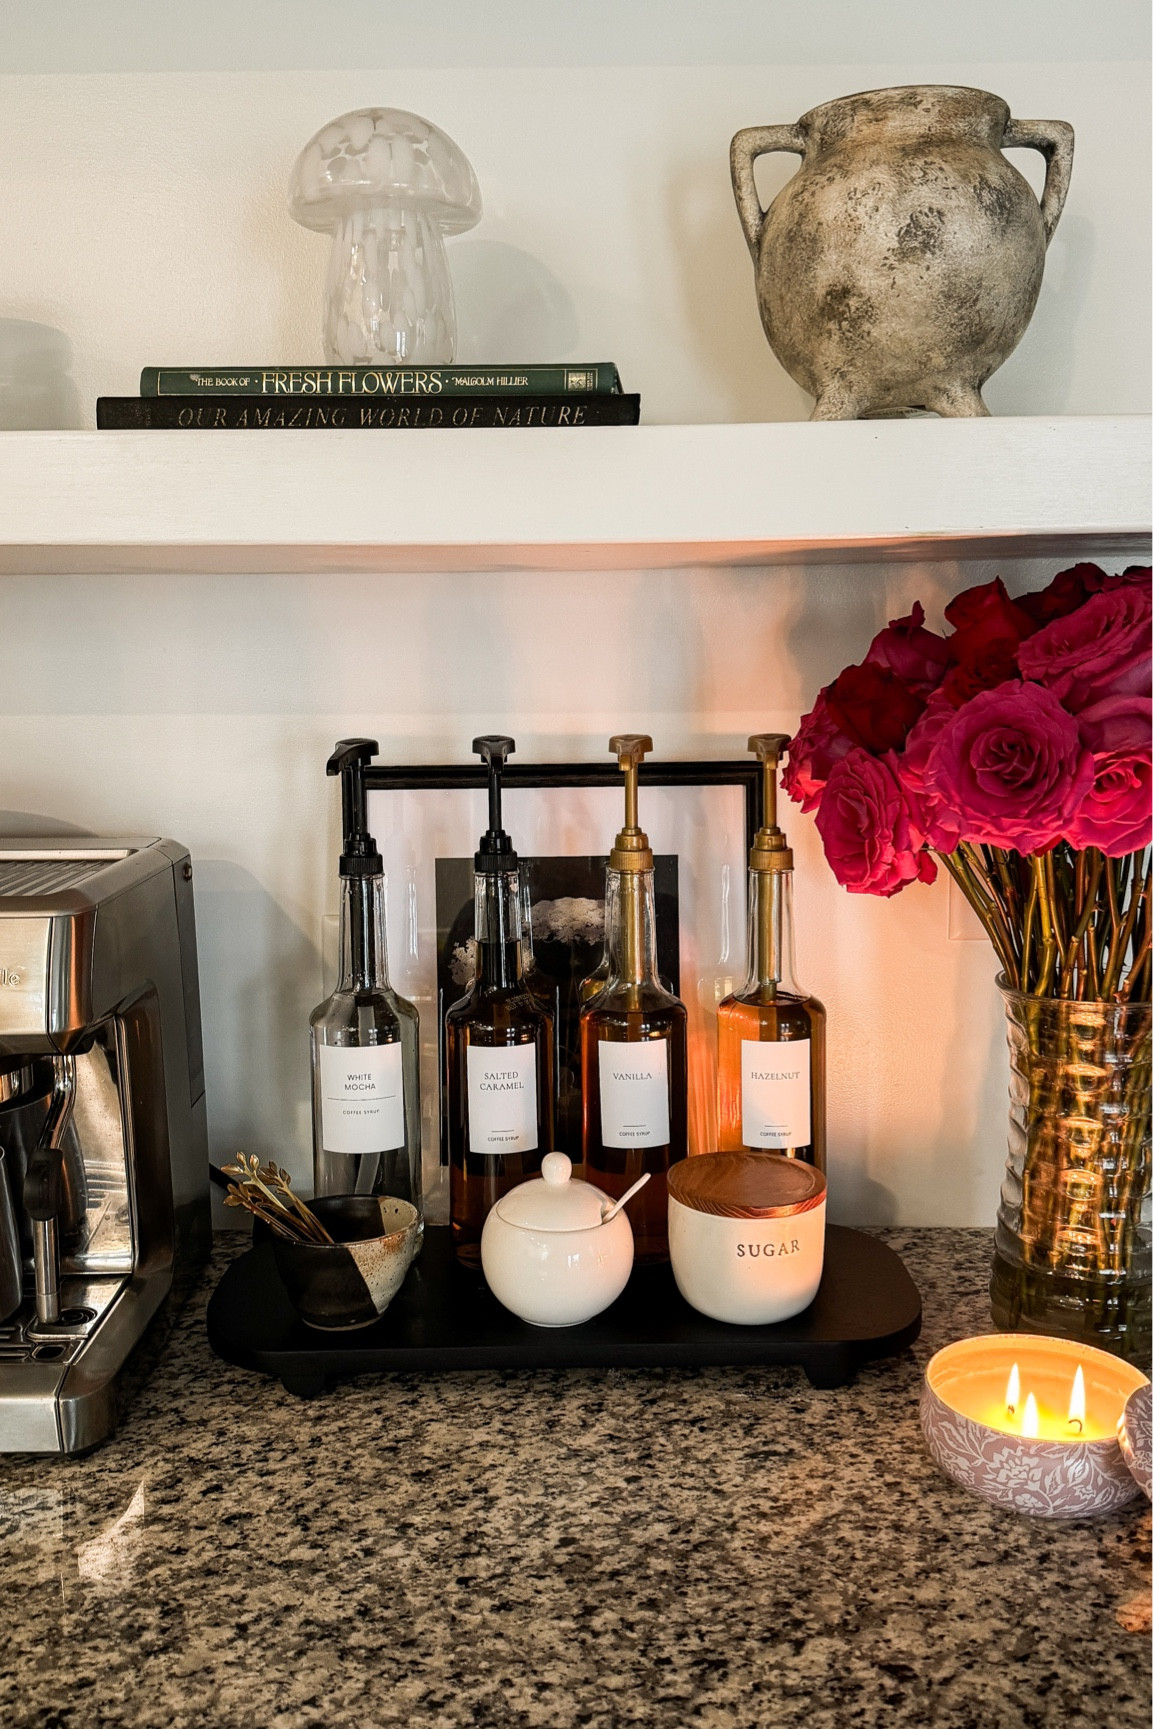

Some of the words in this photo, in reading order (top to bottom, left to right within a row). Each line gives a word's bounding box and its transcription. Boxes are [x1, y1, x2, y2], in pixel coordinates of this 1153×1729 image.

[197, 377, 213, 387] THE
[215, 377, 236, 387] BOOK
[238, 377, 250, 387] OF
[261, 372, 333, 394] FRESH
[338, 371, 443, 394] FLOWERS
[452, 376, 494, 386] MALCOLM
[496, 376, 529, 386] HILLIER
[178, 407, 227, 427] OUR
[236, 407, 347, 427] AMAZING
[360, 407, 443, 427] WORLD
[452, 407, 483, 426] OF
[493, 406, 588, 425] NATURE
[347, 1073, 372, 1081] WHITE
[484, 1071, 519, 1080] SALTED
[612, 1072, 653, 1081] VANILLA
[751, 1071, 801, 1081] HAZELNUT
[344, 1083, 376, 1091] MOCHA
[479, 1082, 525, 1091] CARAMEL
[736, 1239, 800, 1258] SUGAR
